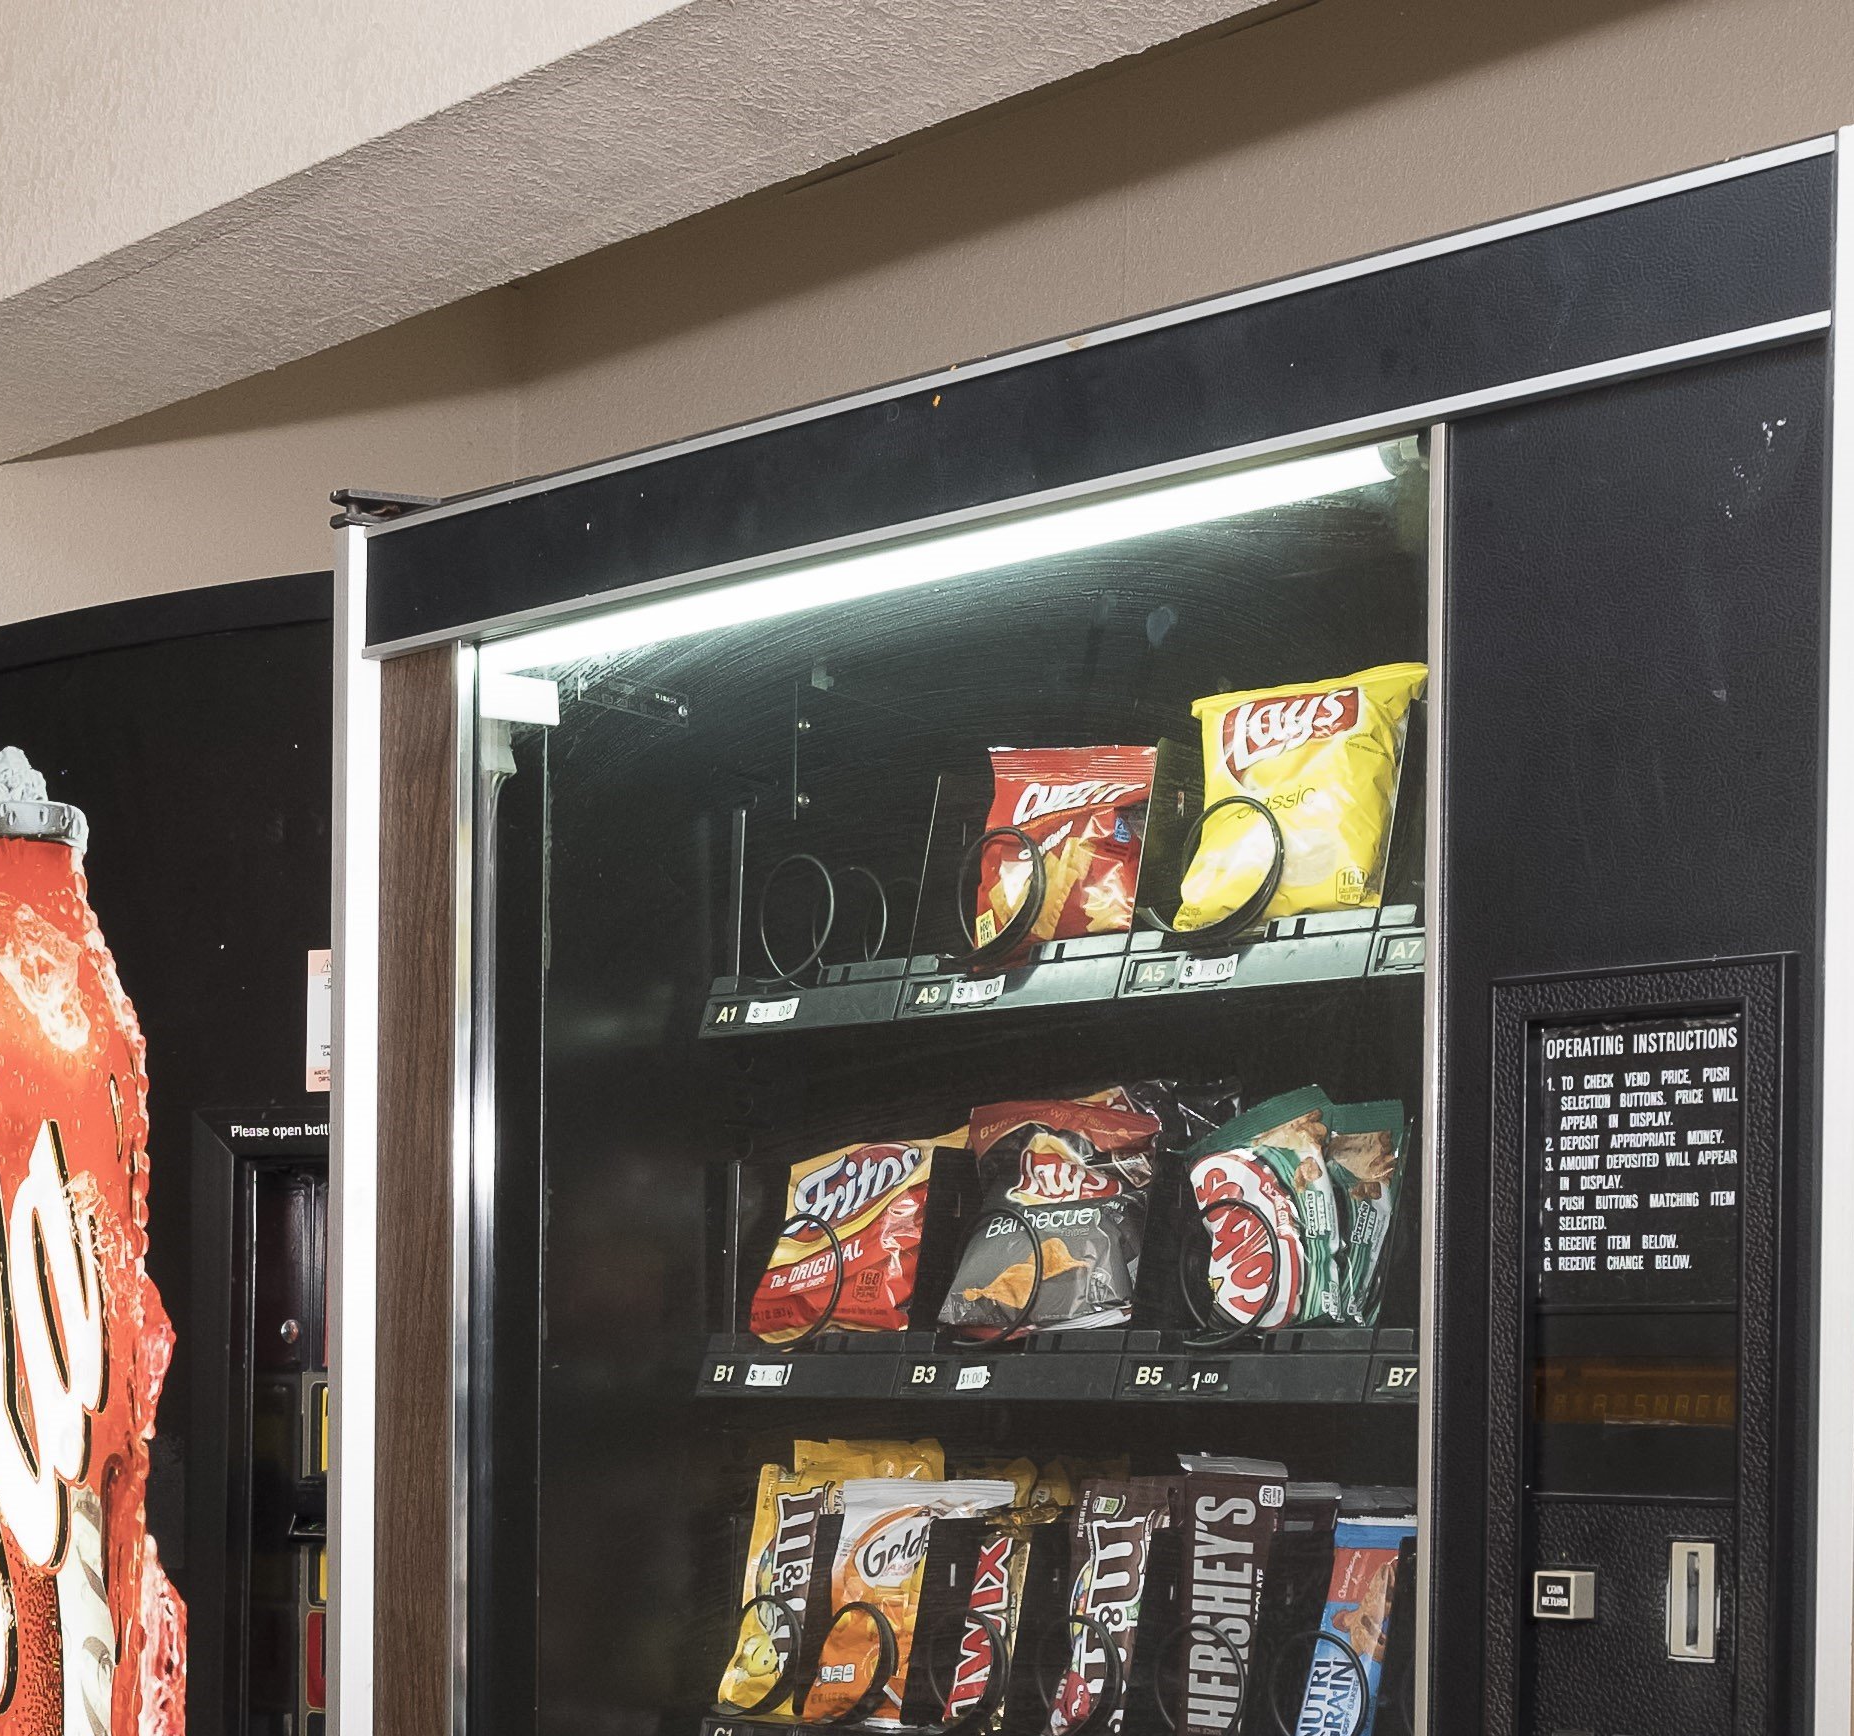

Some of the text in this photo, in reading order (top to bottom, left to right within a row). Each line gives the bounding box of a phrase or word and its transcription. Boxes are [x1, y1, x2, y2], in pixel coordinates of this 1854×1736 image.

[1390, 940, 1422, 960] A7
[1139, 964, 1166, 983] A5
[914, 987, 941, 1005] A3
[716, 1005, 738, 1024] A1
[1547, 1027, 1738, 1059] OPERATING INSTRUCTIONS
[1562, 1067, 1730, 1090] TO CHECK VEND PUSH
[1561, 1087, 1738, 1111] SELECTION BUTTONS. PRICE WILL
[1561, 1111, 1673, 1131] APPEAR IN DISPLAY.
[230, 1124, 302, 1140] Please open
[1560, 1129, 1724, 1150] DEPOSIT APPROPRIATE MONEY.
[1560, 1150, 1738, 1171] AMOUNT DEPOSITED WILL APPEAR
[782, 1147, 921, 1237] Fritos
[1560, 1175, 1623, 1190] IN DISPLAY.
[1559, 1191, 1735, 1210] PUSH BUTTONS MATCHING ITEM
[1559, 1216, 1607, 1231] SELECTED.
[1559, 1234, 1678, 1251] RECEIVE ITEM BELOW.
[1559, 1255, 1692, 1271] RECEIVE CHANGE BELOW.
[713, 1365, 734, 1382] B1
[911, 1365, 937, 1384] B3
[1135, 1366, 1219, 1391] B5 1.00
[1387, 1367, 1417, 1387] B7
[1187, 1496, 1257, 1730] HERSHEY'S
